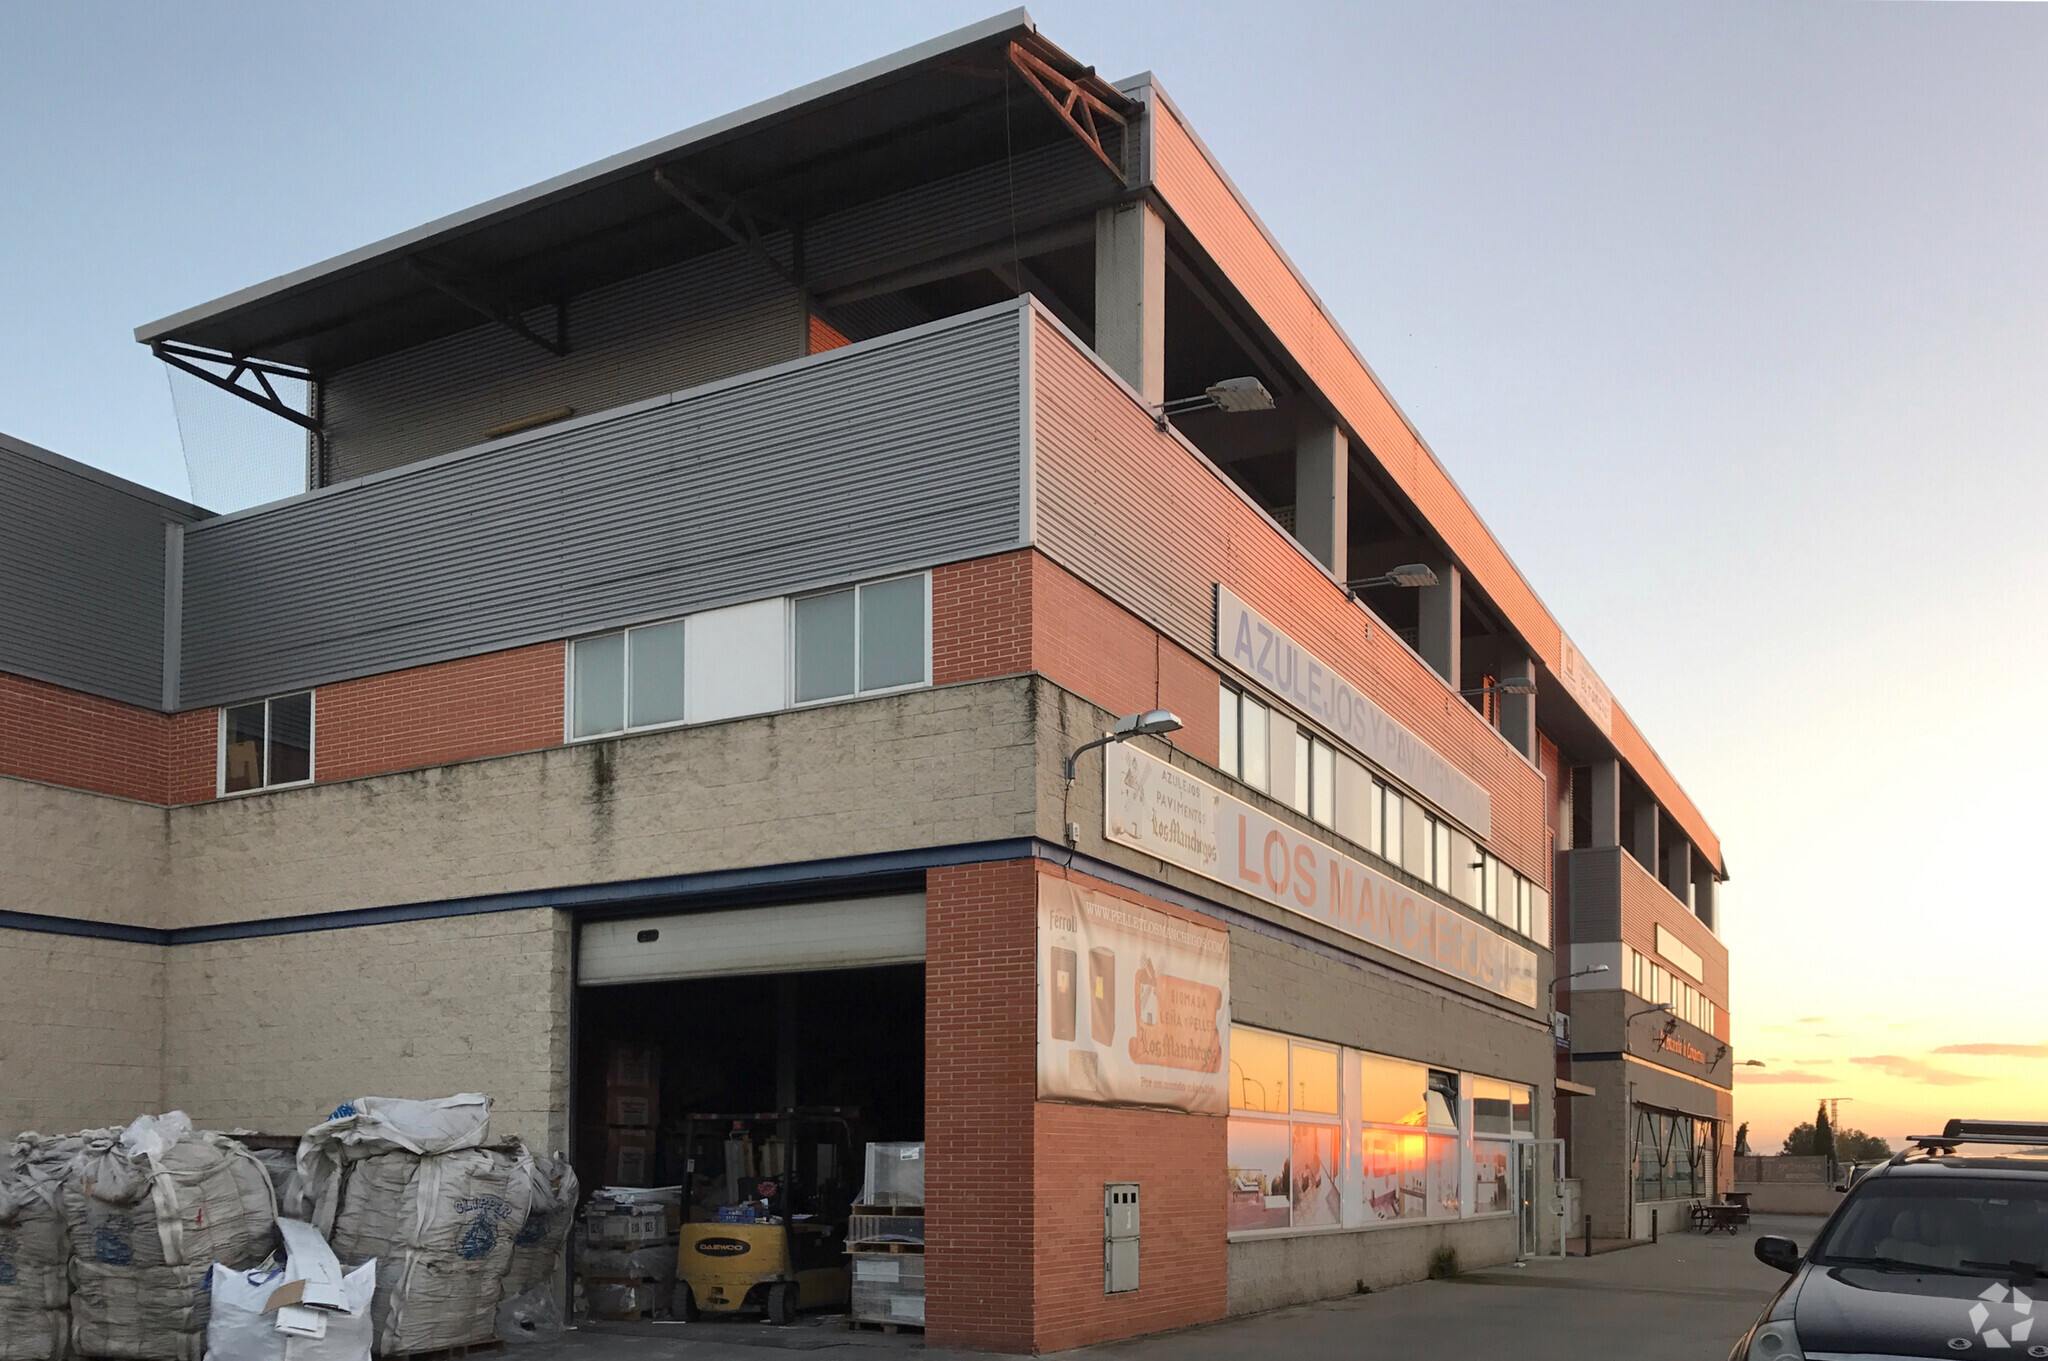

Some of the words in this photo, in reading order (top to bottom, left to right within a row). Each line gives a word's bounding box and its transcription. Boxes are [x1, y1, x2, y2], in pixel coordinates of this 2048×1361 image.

[1233, 609, 1366, 752] AZULEJOS
[1369, 706, 1382, 753] Y
[1161, 770, 1201, 798] AZULEJOS
[1156, 790, 1205, 825] PAVIMENTOS
[1238, 813, 1317, 908] LOS
[1329, 858, 1494, 984] MANCHEGOS
[1050, 909, 1077, 933] Ferroli
[1170, 989, 1207, 1010] BIOMASA
[1160, 1009, 1182, 1028] LEÑA
[454, 1195, 512, 1219] CLIPPER
[700, 1243, 743, 1251] DAEWOO
